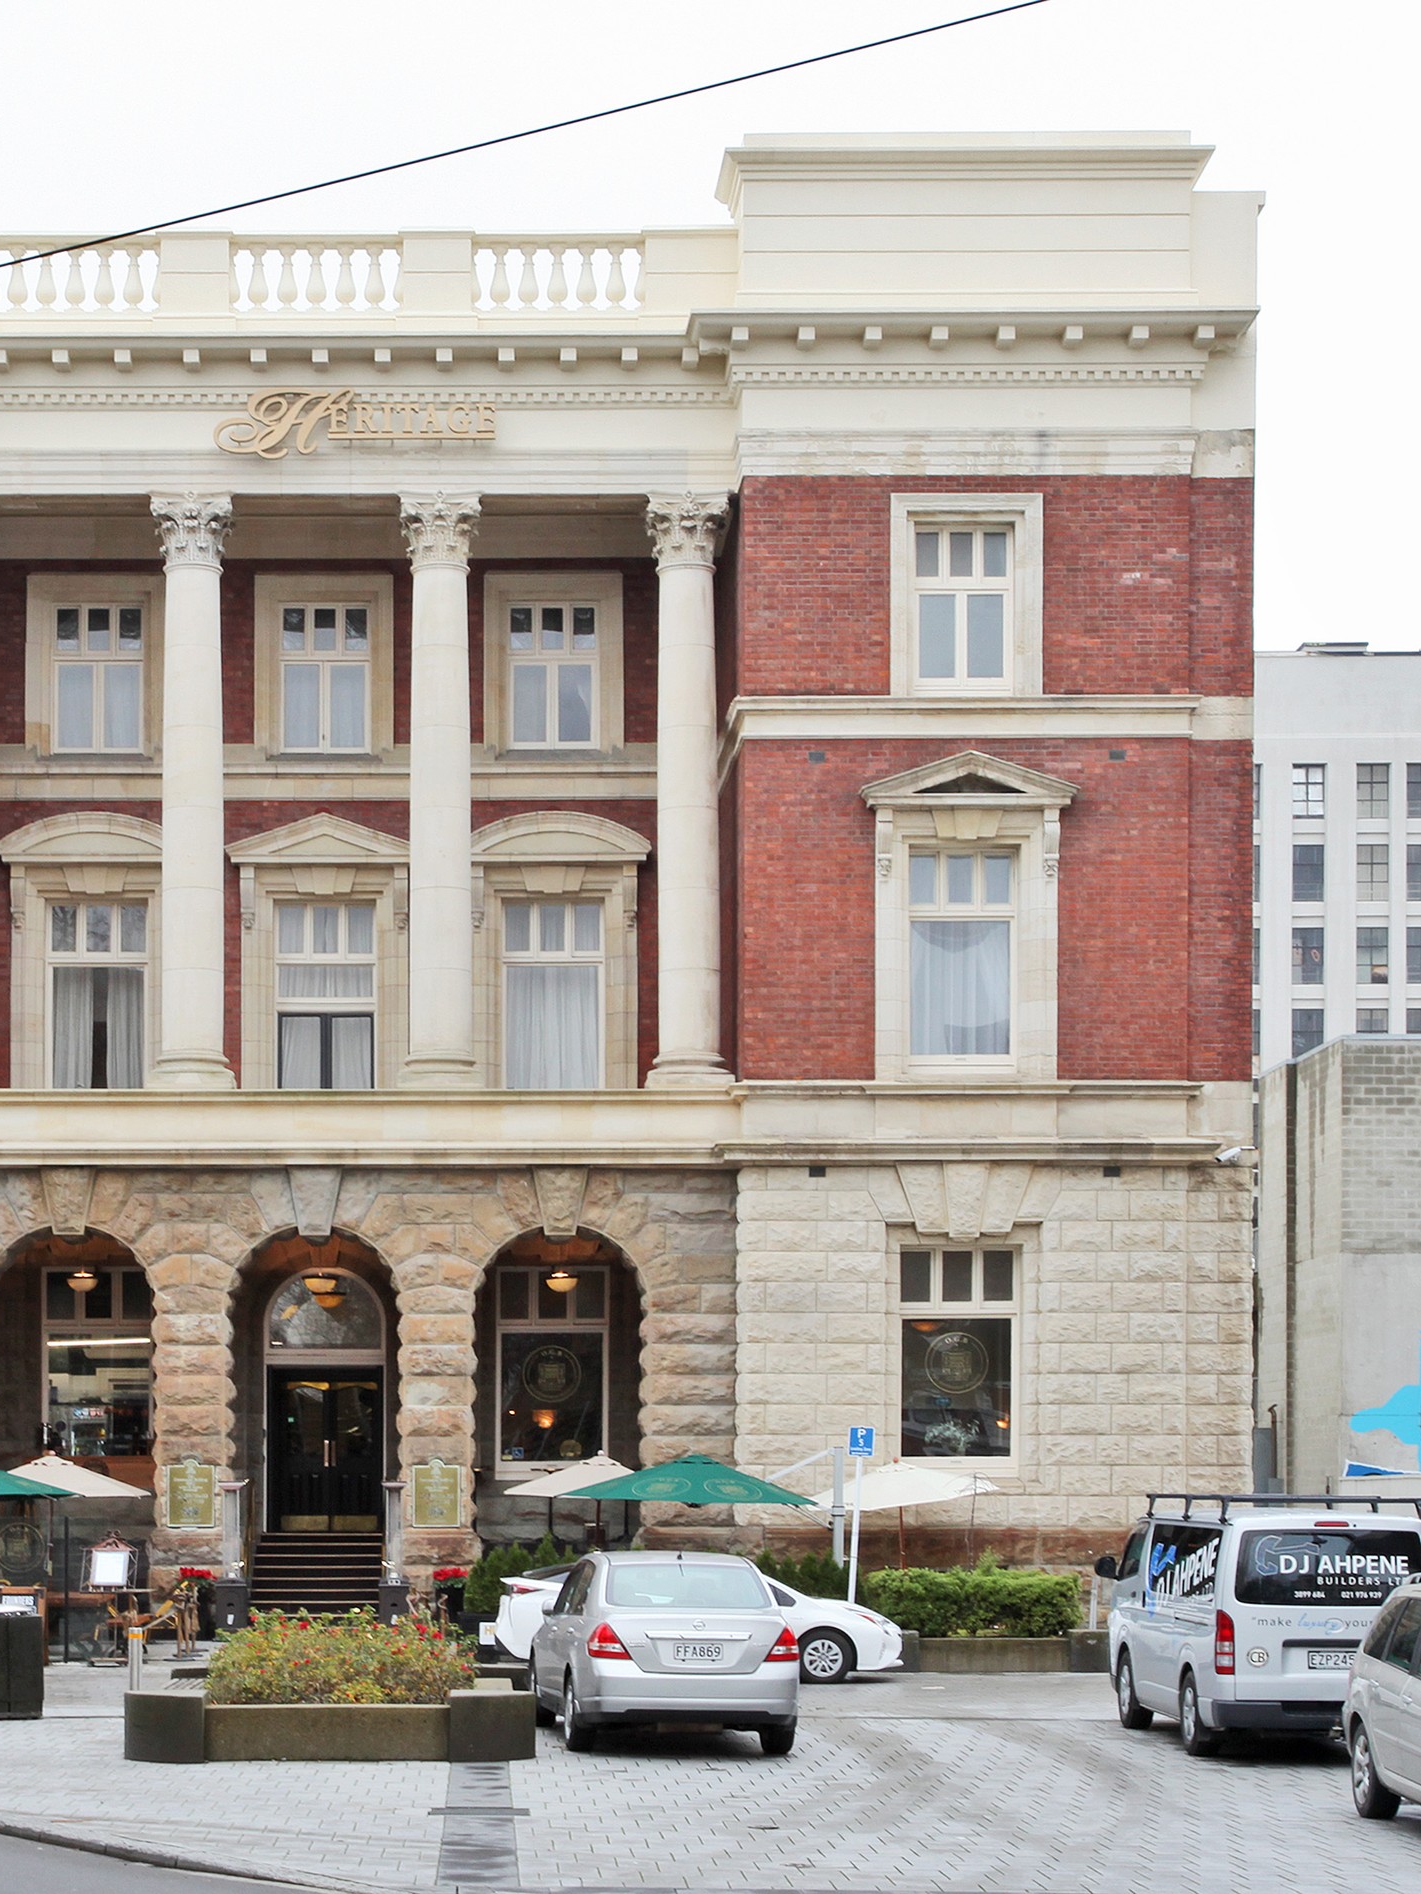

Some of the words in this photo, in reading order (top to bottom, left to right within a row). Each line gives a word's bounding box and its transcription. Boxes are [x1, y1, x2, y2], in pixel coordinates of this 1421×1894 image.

[213, 387, 496, 460] HERITAGE
[857, 1428, 867, 1439] P
[1172, 1537, 1220, 1601] AHPENE
[1279, 1554, 1310, 1574] DJ
[1317, 1554, 1410, 1574] AHPENE
[1317, 1576, 1381, 1586] BUILDERS
[1340, 1591, 1354, 1599] 021
[676, 1646, 721, 1658] FFA869
[1310, 1654, 1355, 1666] EZP245
